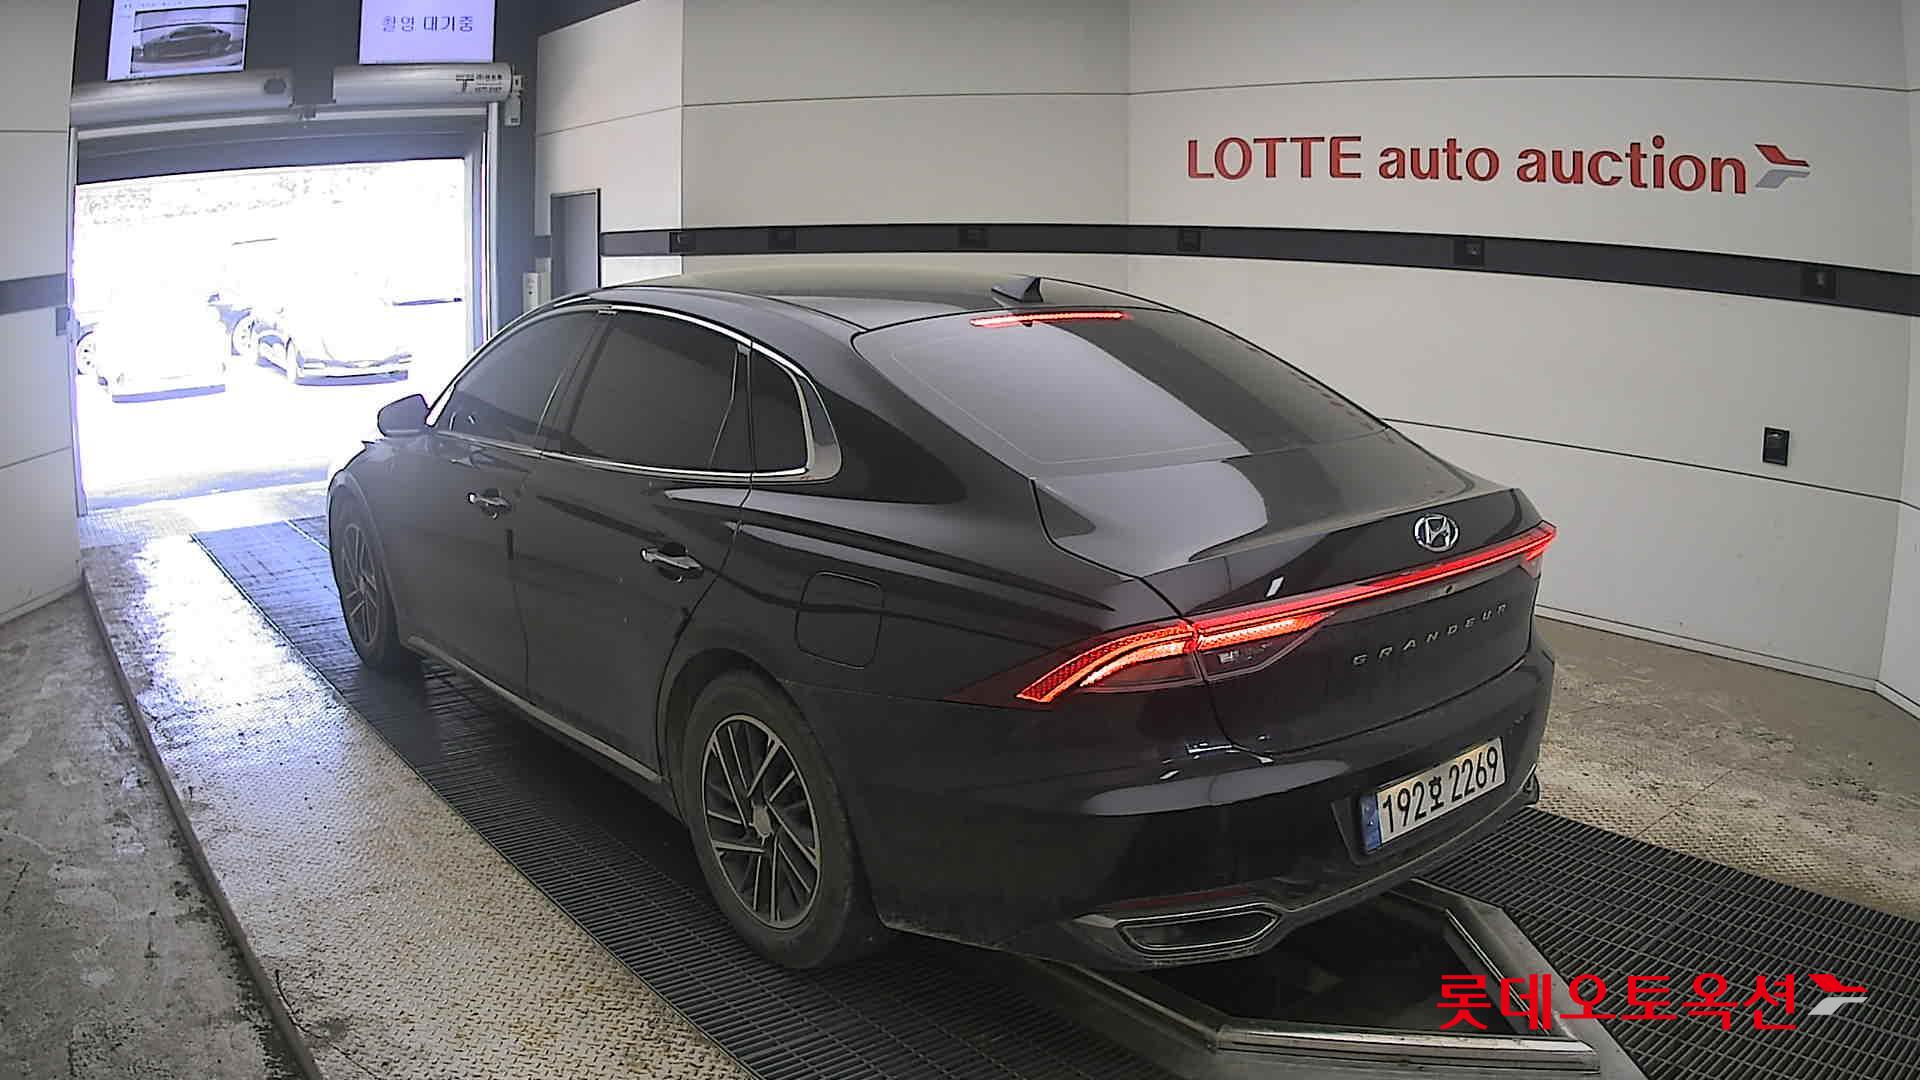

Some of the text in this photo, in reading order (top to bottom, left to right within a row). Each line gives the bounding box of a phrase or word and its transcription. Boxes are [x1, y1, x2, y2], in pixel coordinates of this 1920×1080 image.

[423, 15, 473, 33] 대기중
[1187, 135, 1747, 195] LOTTE auto auction
[1352, 603, 1508, 665] GRANDEUR
[1382, 746, 1499, 833] 192호 2269
